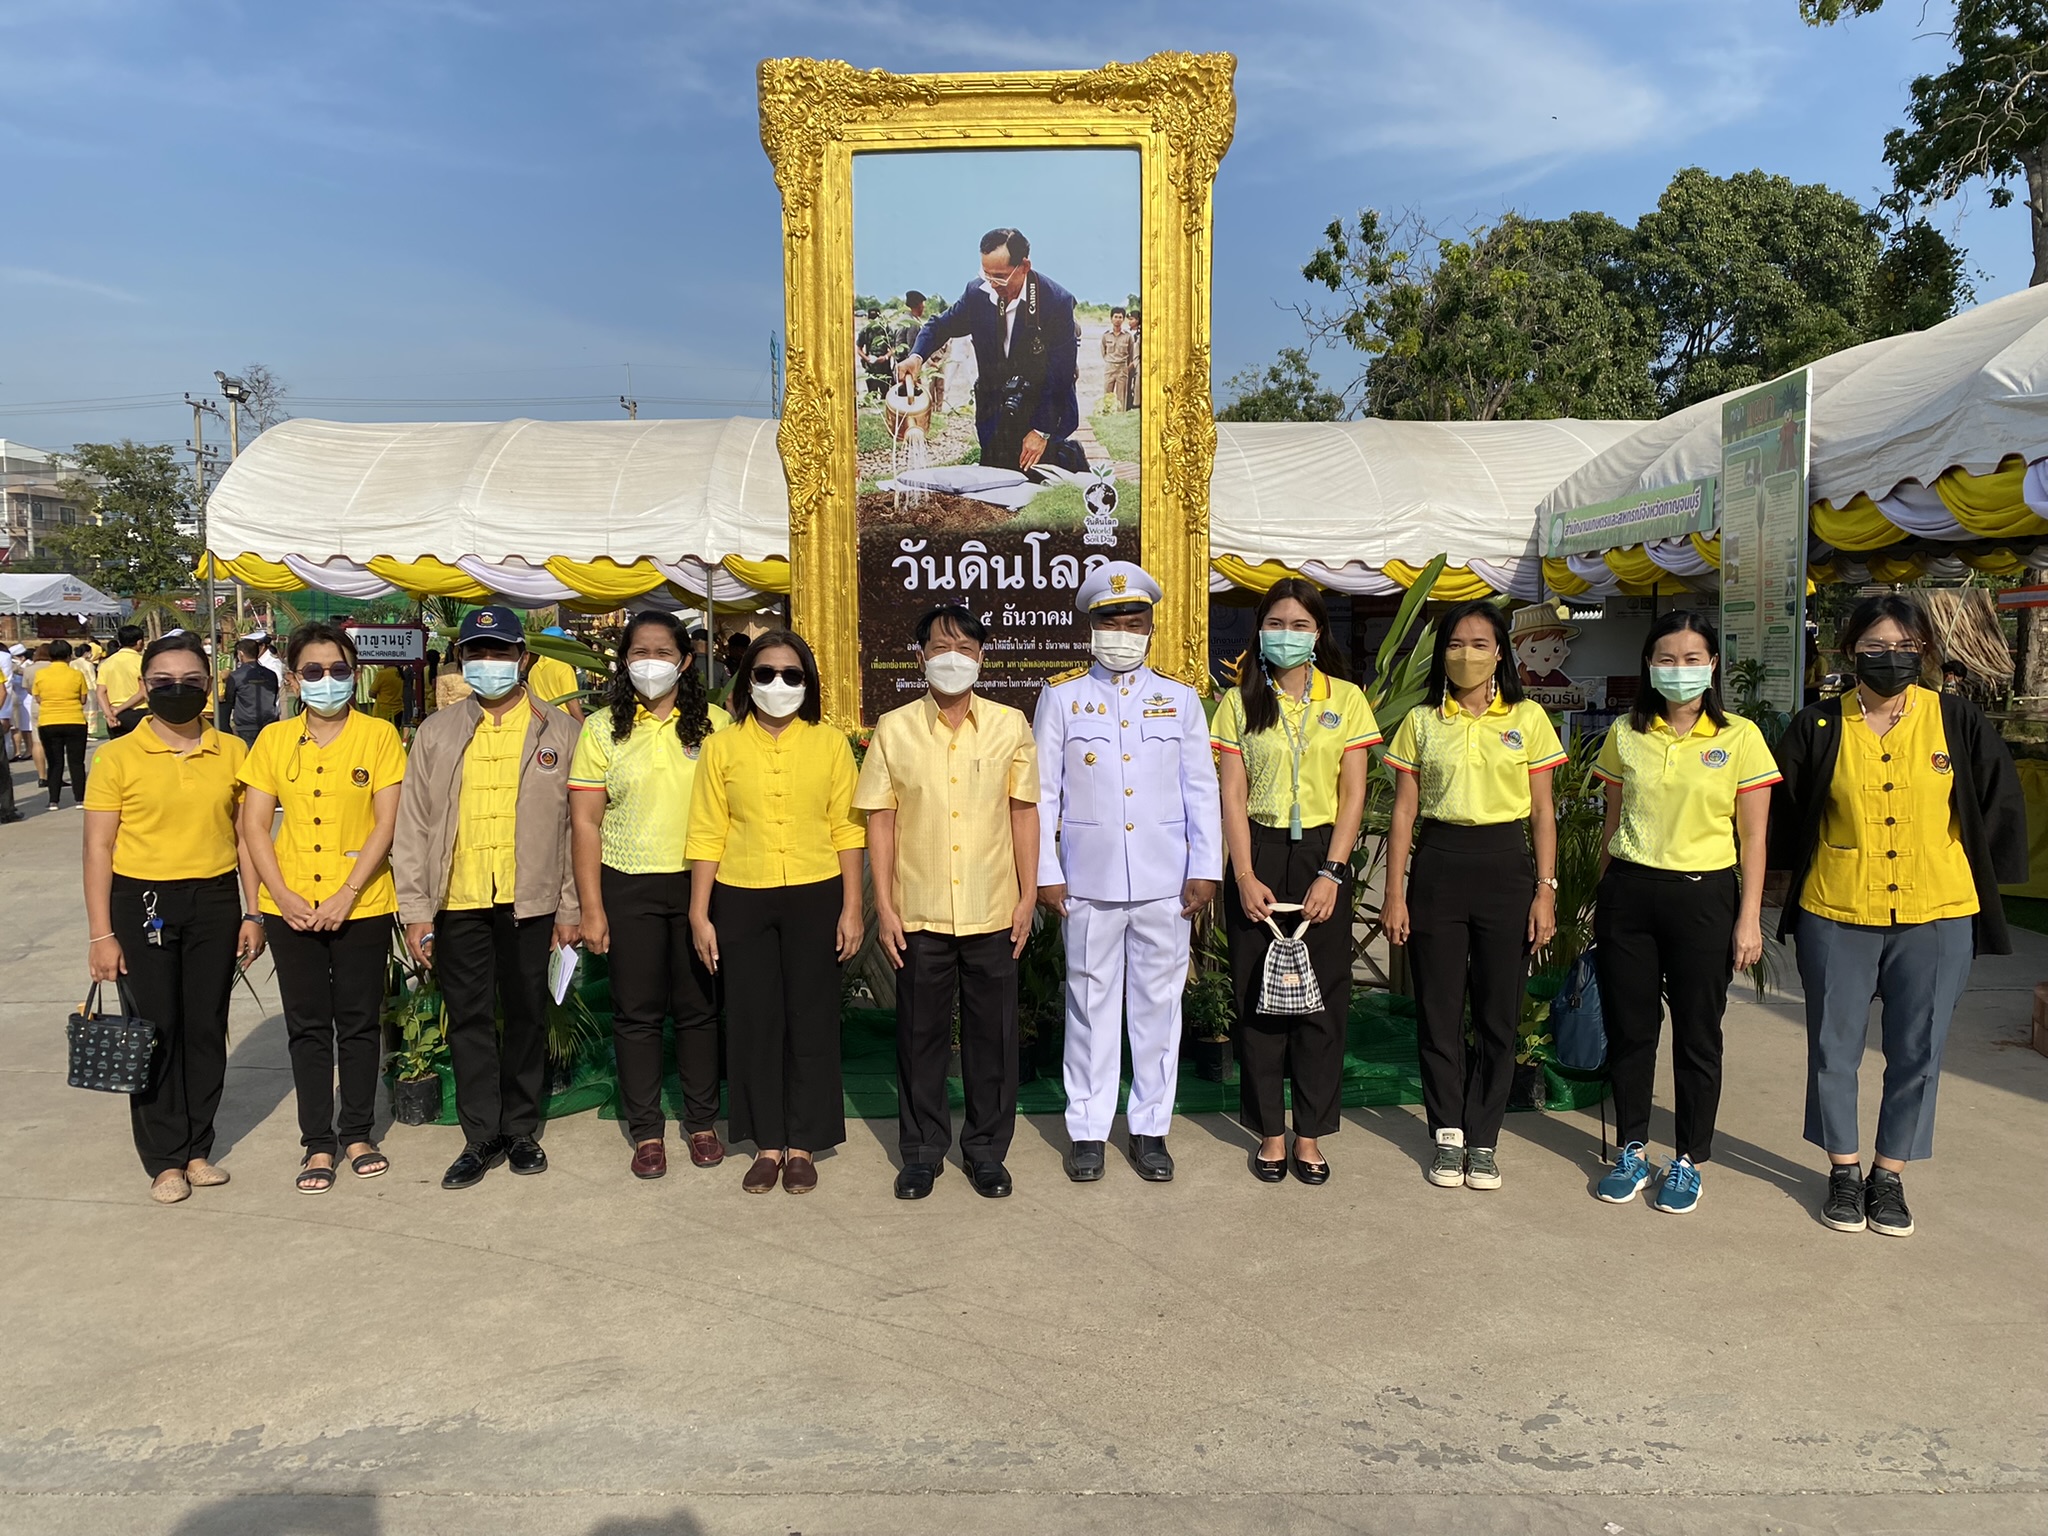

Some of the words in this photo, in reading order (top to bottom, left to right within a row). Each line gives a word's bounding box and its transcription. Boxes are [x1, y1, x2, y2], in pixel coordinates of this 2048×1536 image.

[1090, 527, 1112, 535] World
[1085, 535, 1100, 543] Soil
[1101, 535, 1116, 546] Day
[1002, 603, 1073, 626] ธันวาคม
[355, 631, 413, 649] กาญจนบุรี
[1038, 642, 1043, 650] 5
